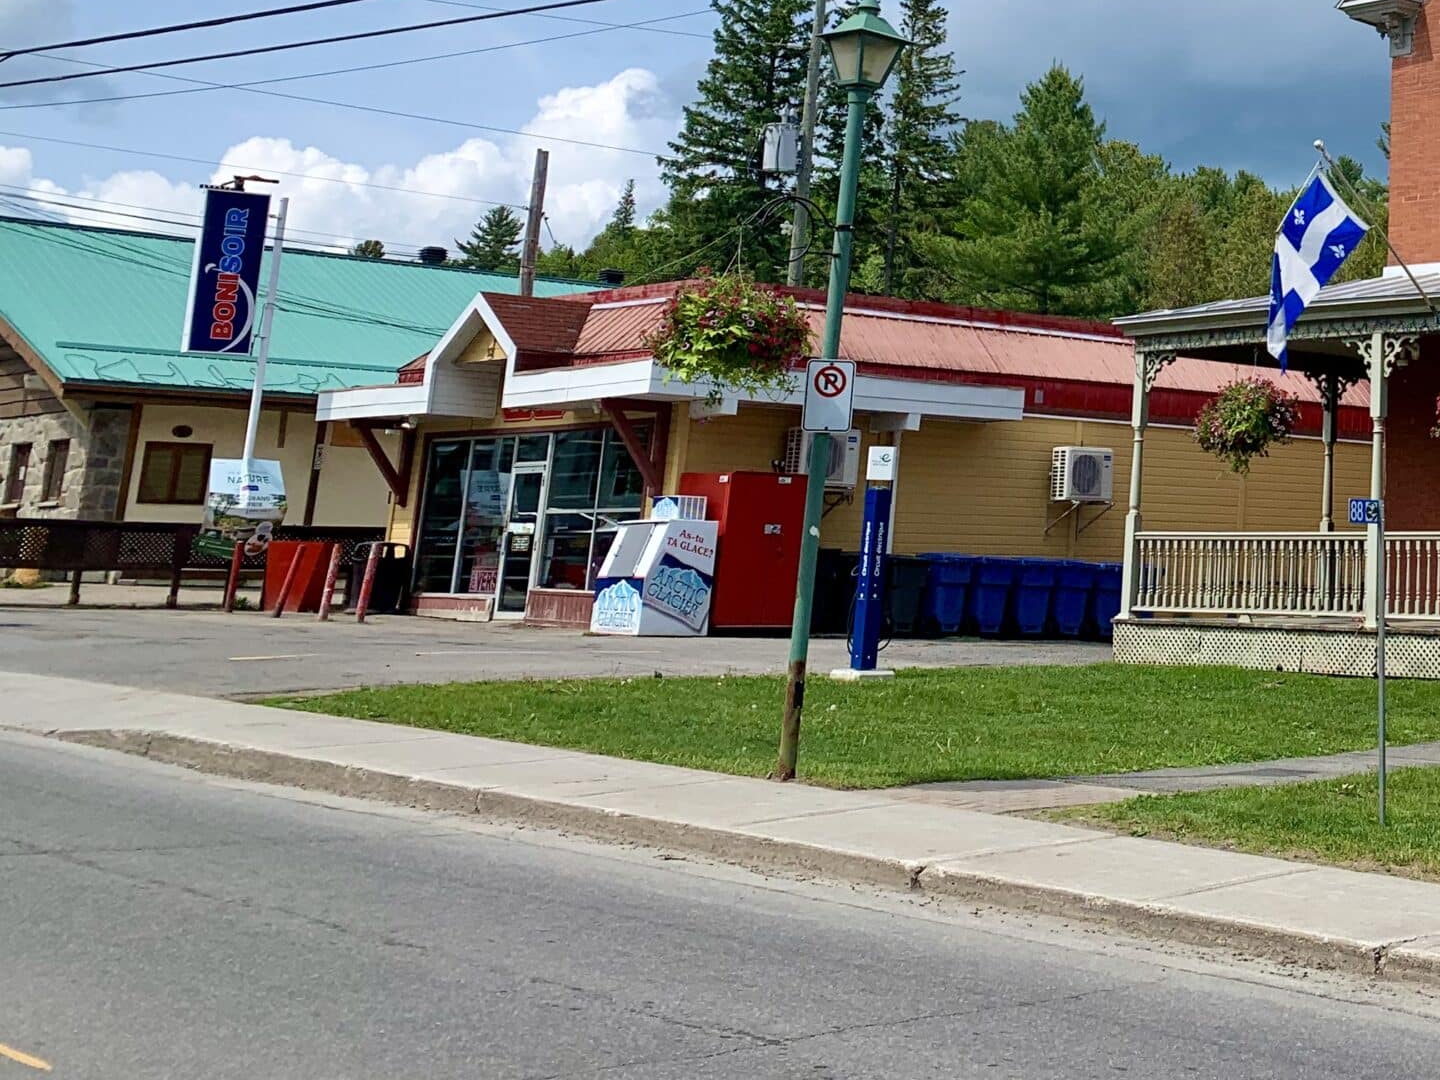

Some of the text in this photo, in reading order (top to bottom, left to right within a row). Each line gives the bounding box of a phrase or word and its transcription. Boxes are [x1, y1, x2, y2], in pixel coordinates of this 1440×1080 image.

[1350, 500, 1364, 521] 88
[666, 536, 715, 558] TA GLACE?
[679, 529, 704, 544] As-tu
[652, 567, 708, 606] ARCTIC
[646, 583, 700, 618] GLACIER
